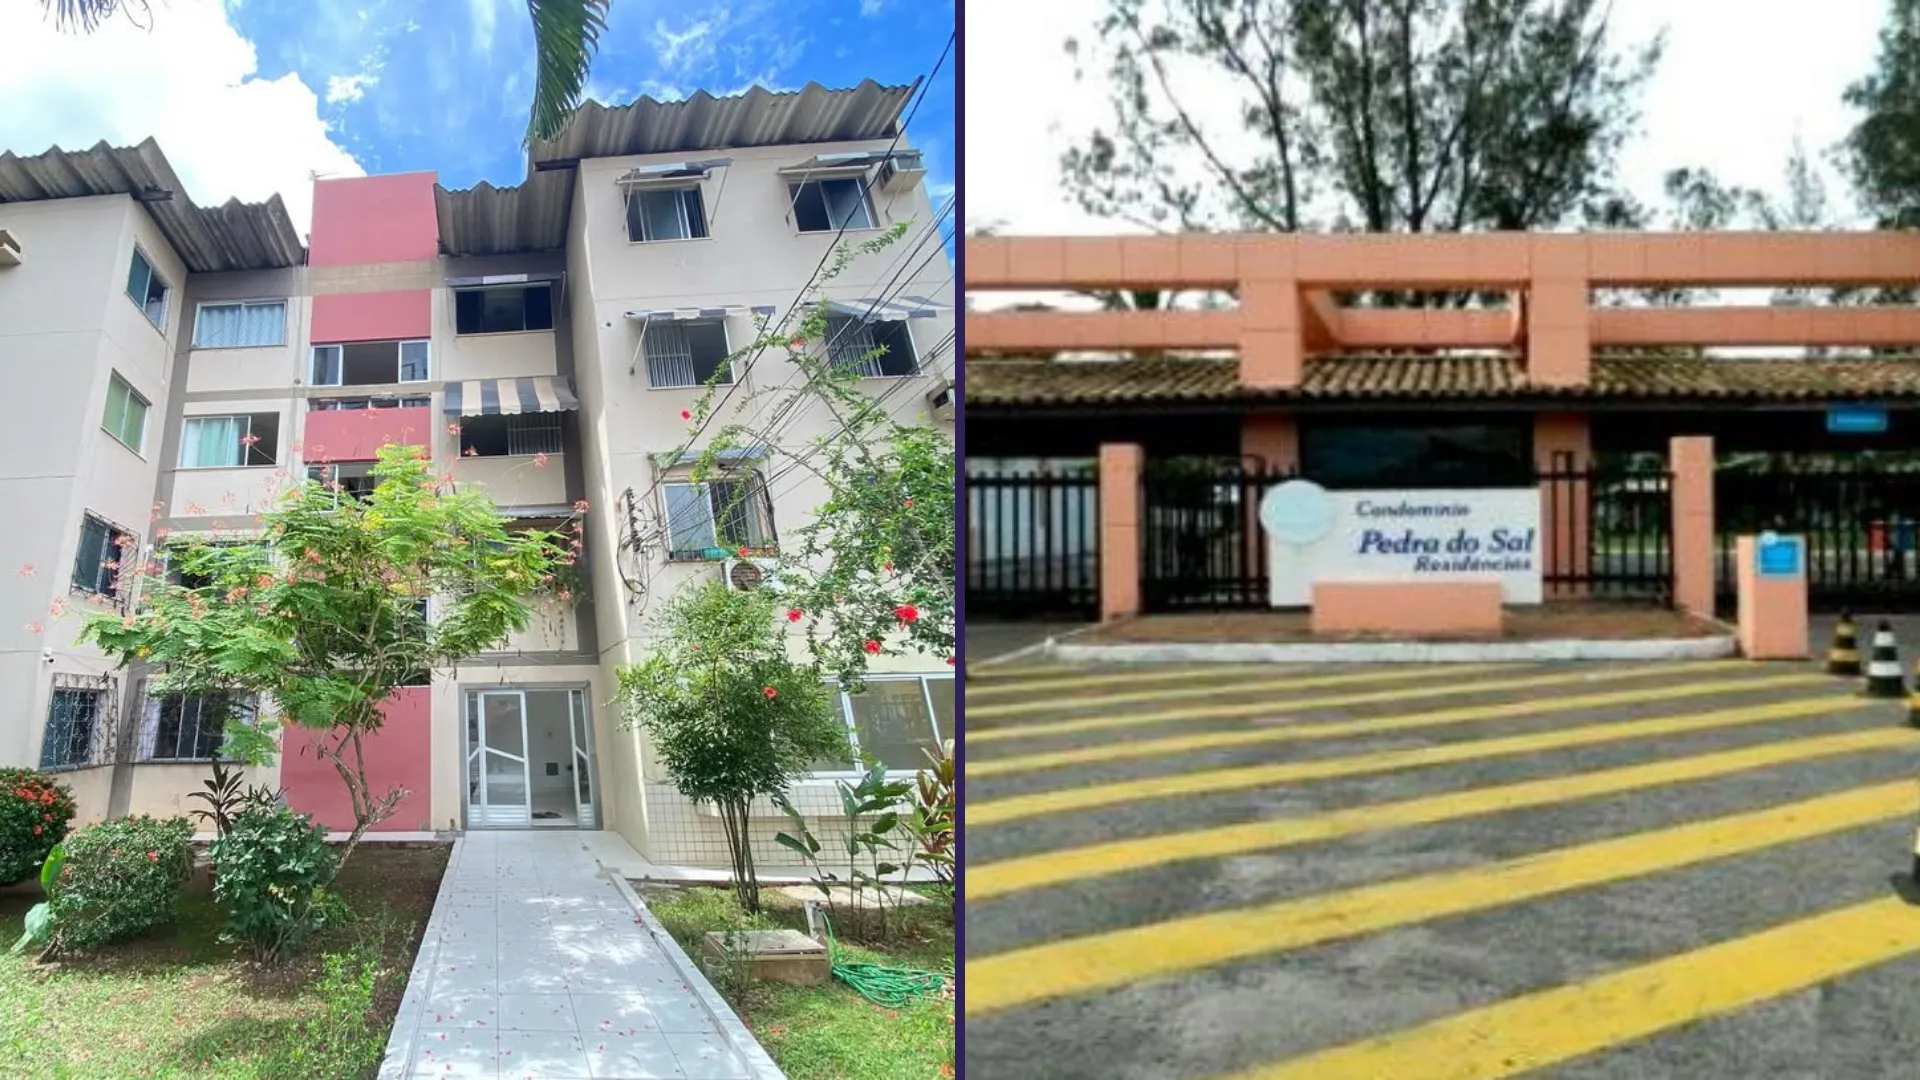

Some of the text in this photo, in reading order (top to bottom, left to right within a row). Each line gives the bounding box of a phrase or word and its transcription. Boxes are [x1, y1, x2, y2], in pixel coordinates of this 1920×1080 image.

[1358, 528, 1535, 553] Pedra do Sal
